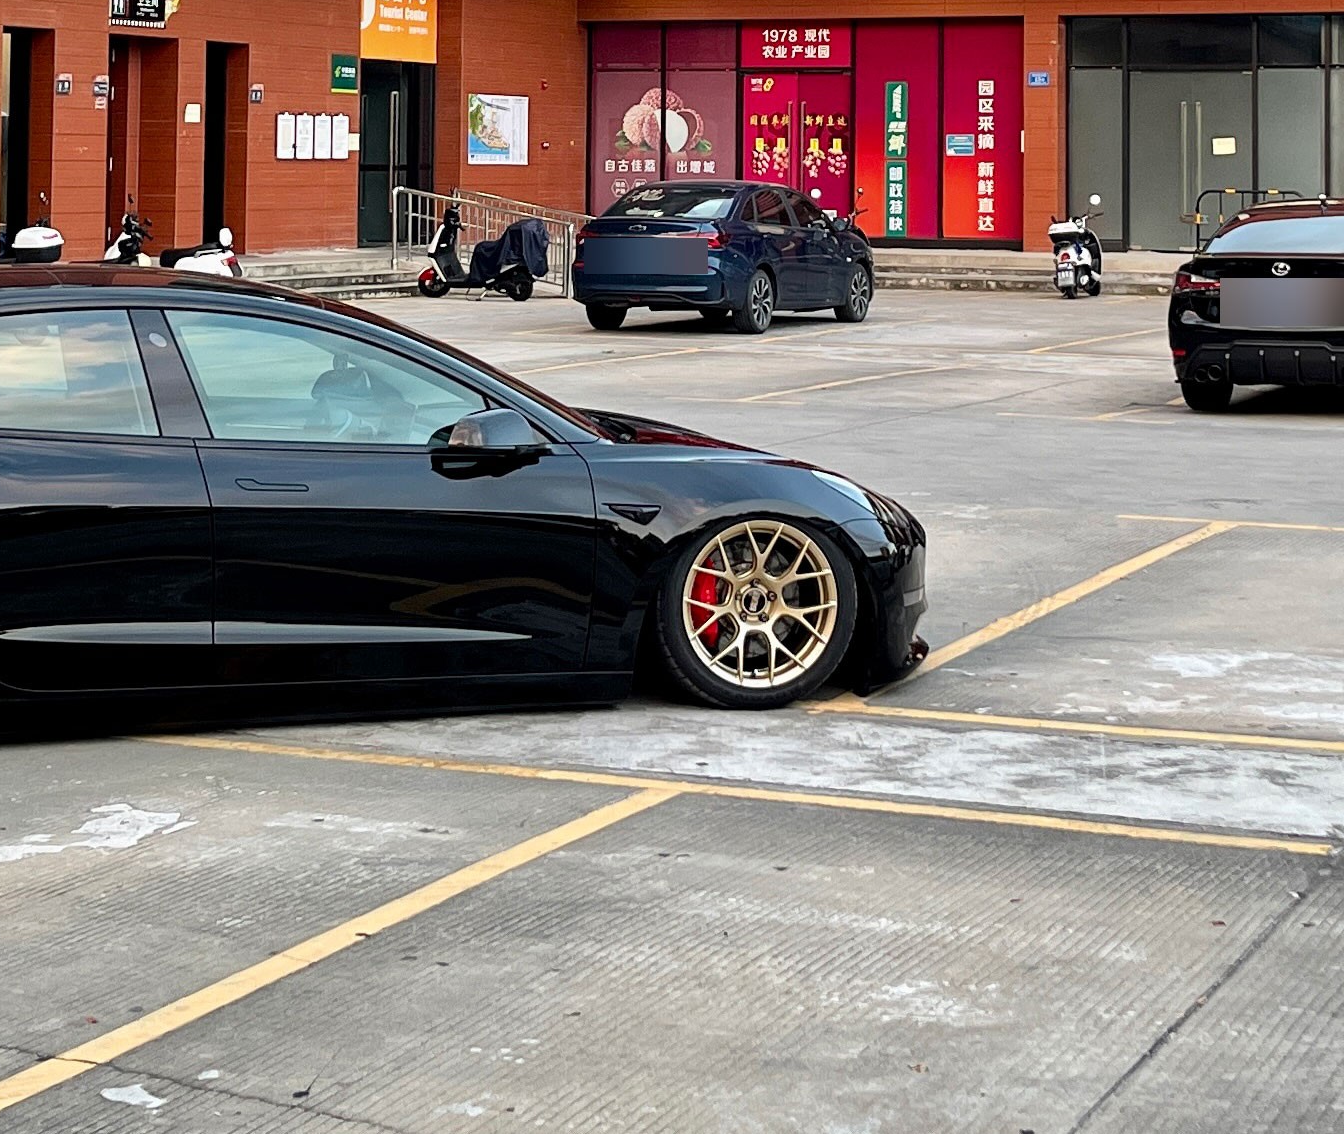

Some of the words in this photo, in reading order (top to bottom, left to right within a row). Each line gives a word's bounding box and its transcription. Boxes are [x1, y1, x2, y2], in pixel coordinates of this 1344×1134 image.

[762, 29, 798, 43] 1978
[804, 29, 831, 42] 现代
[762, 45, 788, 58] 农业
[791, 45, 830, 59] 产业园
[977, 80, 995, 150] 园区采摘
[977, 161, 995, 232] 新鲜直达
